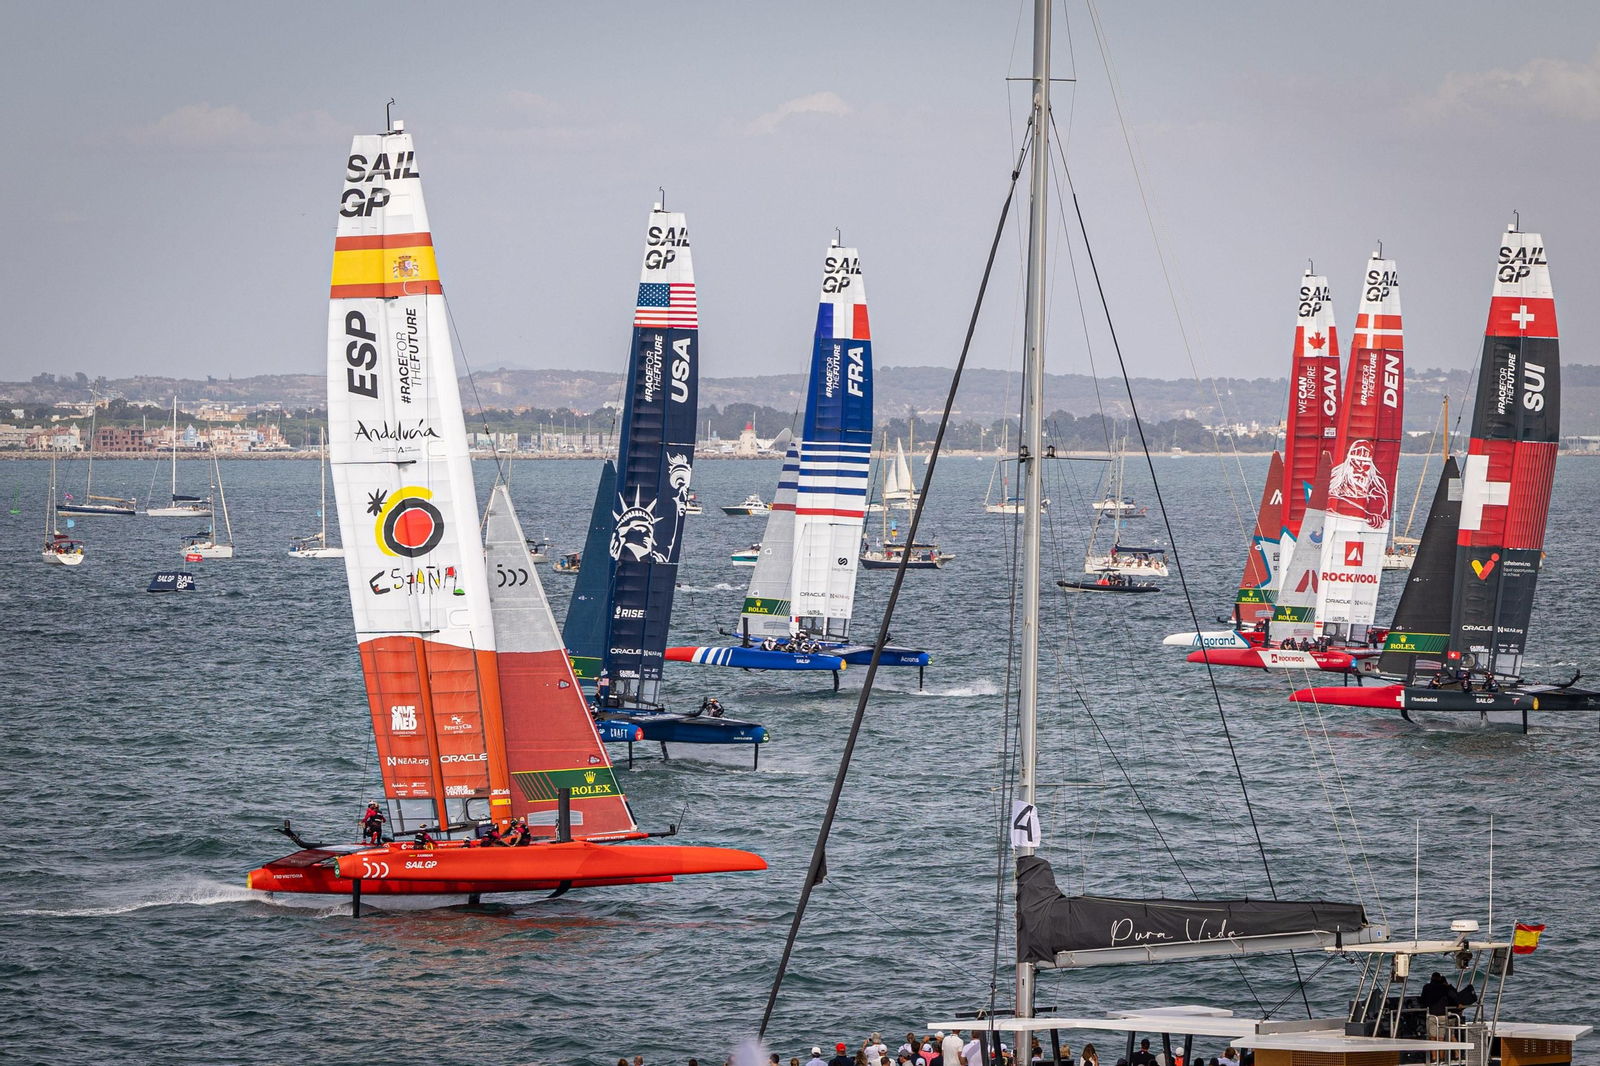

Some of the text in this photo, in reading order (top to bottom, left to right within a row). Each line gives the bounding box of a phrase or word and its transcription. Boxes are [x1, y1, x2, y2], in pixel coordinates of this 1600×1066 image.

[345, 151, 420, 183] SAIL
[339, 187, 391, 218] GP
[646, 226, 690, 247] SAIL
[645, 249, 676, 270] GP
[1498, 246, 1548, 265] SAIL
[824, 257, 862, 275] SAIL
[1497, 265, 1531, 283] GP
[822, 276, 851, 294] GP
[1366, 270, 1399, 287] SAIL
[1300, 286, 1332, 302] SAIL
[1366, 286, 1390, 302] GP
[1299, 302, 1322, 317] GP
[345, 310, 379, 399] ESP
[671, 338, 691, 404] USA
[848, 346, 864, 397] FRA
[1307, 365, 1316, 399] INSPIRE
[1384, 354, 1400, 408] DEN
[1523, 361, 1546, 412] SUI
[1298, 376, 1308, 414] WE CAN
[1323, 366, 1337, 417] CAN
[354, 418, 441, 442] Andalucía
[177, 574, 194, 584] SAIL
[368, 563, 466, 597] ESPAÑA
[1321, 572, 1378, 584] ROCKWOOL
[620, 609, 645, 618] RISE
[1462, 624, 1493, 632] ORACLE
[610, 647, 642, 655] ORACLE
[391, 705, 416, 718] SAVE
[391, 717, 418, 731] MED
[397, 757, 429, 766] NEAR.org
[440, 753, 488, 763] ORACLE
[571, 784, 612, 795] ROLEX
[1014, 804, 1034, 842] 4
[1111, 918, 1244, 947] Pura Vida
